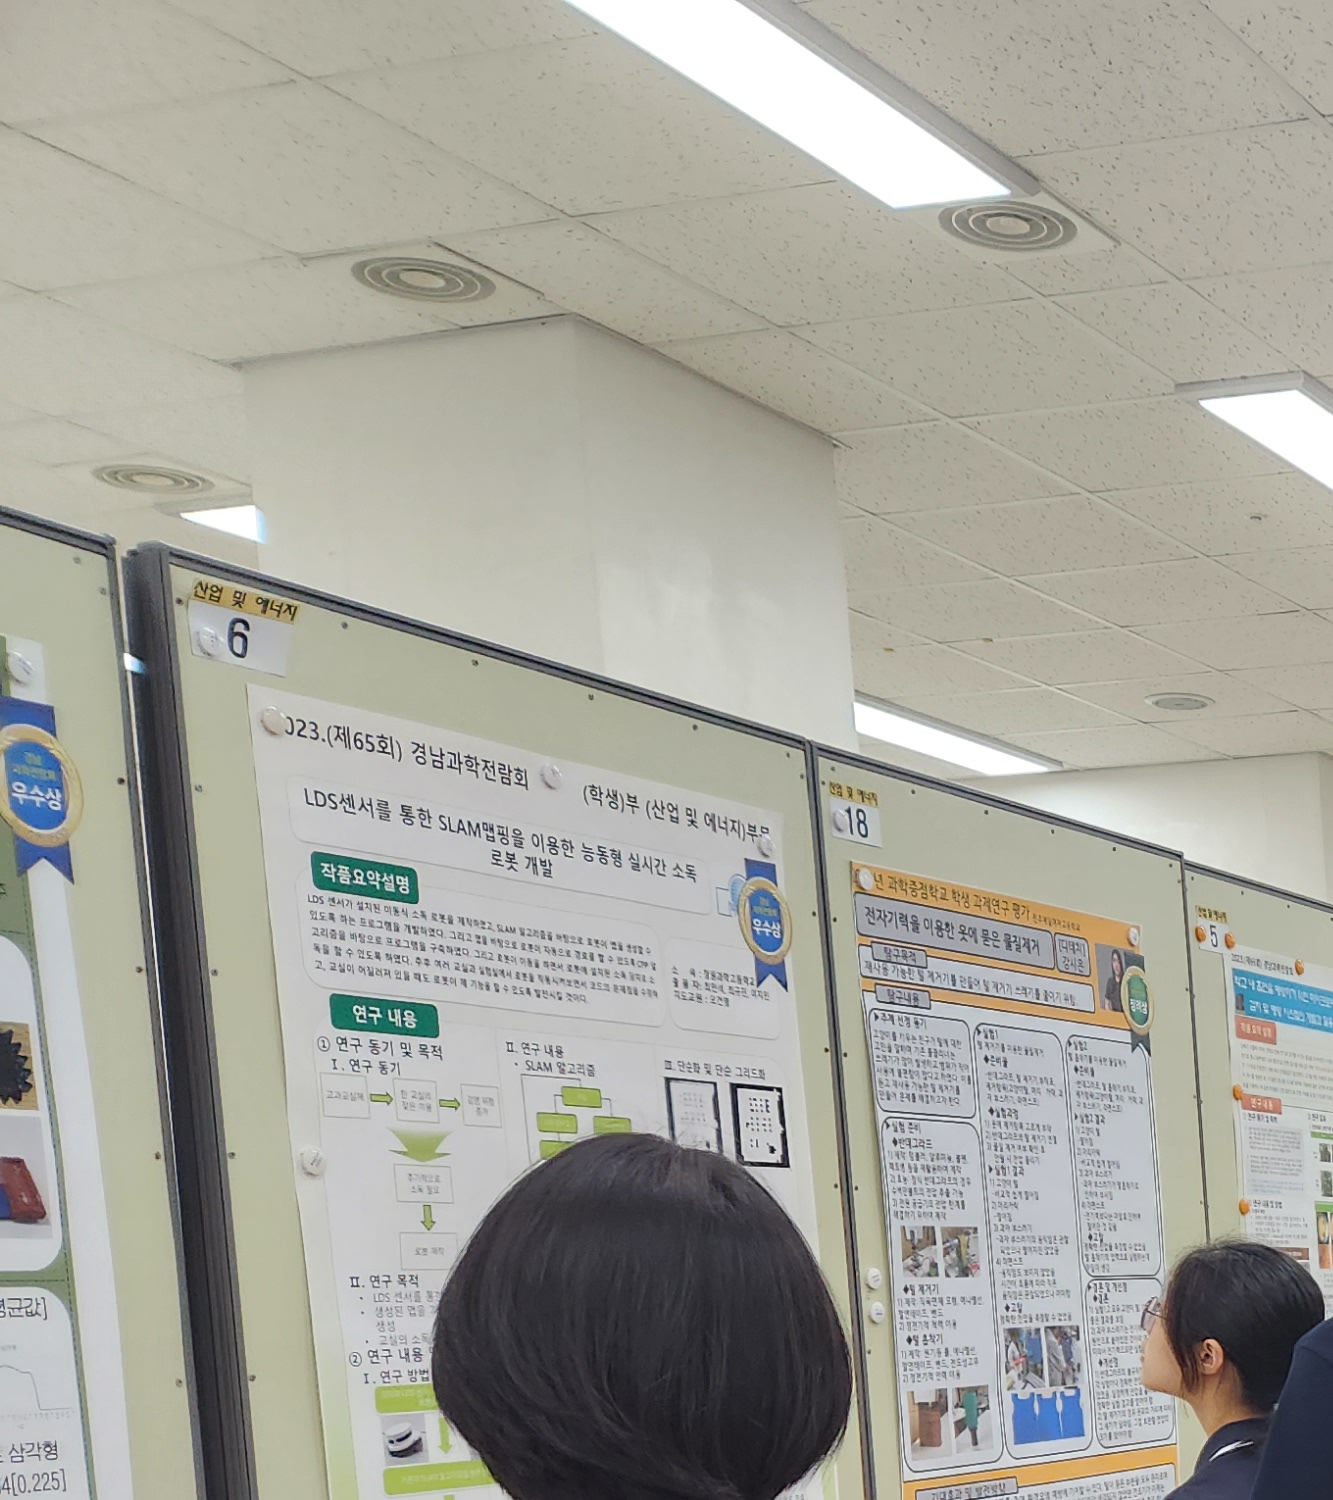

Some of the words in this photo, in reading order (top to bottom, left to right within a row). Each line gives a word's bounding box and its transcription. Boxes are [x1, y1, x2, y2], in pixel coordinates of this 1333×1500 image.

[227, 617, 250, 658] 6
[11, 781, 62, 811] 우수상
[411, 741, 529, 791] 경남과학전람회
[685, 807, 699, 829] 및
[846, 805, 868, 839] 18
[303, 788, 392, 822] LDS센서를
[400, 804, 433, 830] 통한
[531, 833, 574, 859] 이용한
[628, 853, 666, 877] 실시간
[672, 861, 697, 883] 소독
[490, 849, 519, 873] 로봇
[525, 855, 553, 879] 개발
[320, 862, 410, 895] 작품요약설명
[923, 917, 954, 940] 이용한
[1210, 924, 1219, 948] 5
[352, 1005, 383, 1026] 연구
[388, 1008, 418, 1029] 내용
[335, 1036, 362, 1054] 연구
[368, 1038, 393, 1057] 동기
[399, 1041, 412, 1059] 및
[418, 1042, 443, 1061] 목적
[349, 1058, 373, 1074] 연구
[369, 1275, 392, 1290] 연구
[397, 1273, 420, 1289] 목적
[367, 1349, 394, 1365] 연구
[379, 1369, 403, 1385] 연구
[8, 1440, 60, 1464] 삼각형
